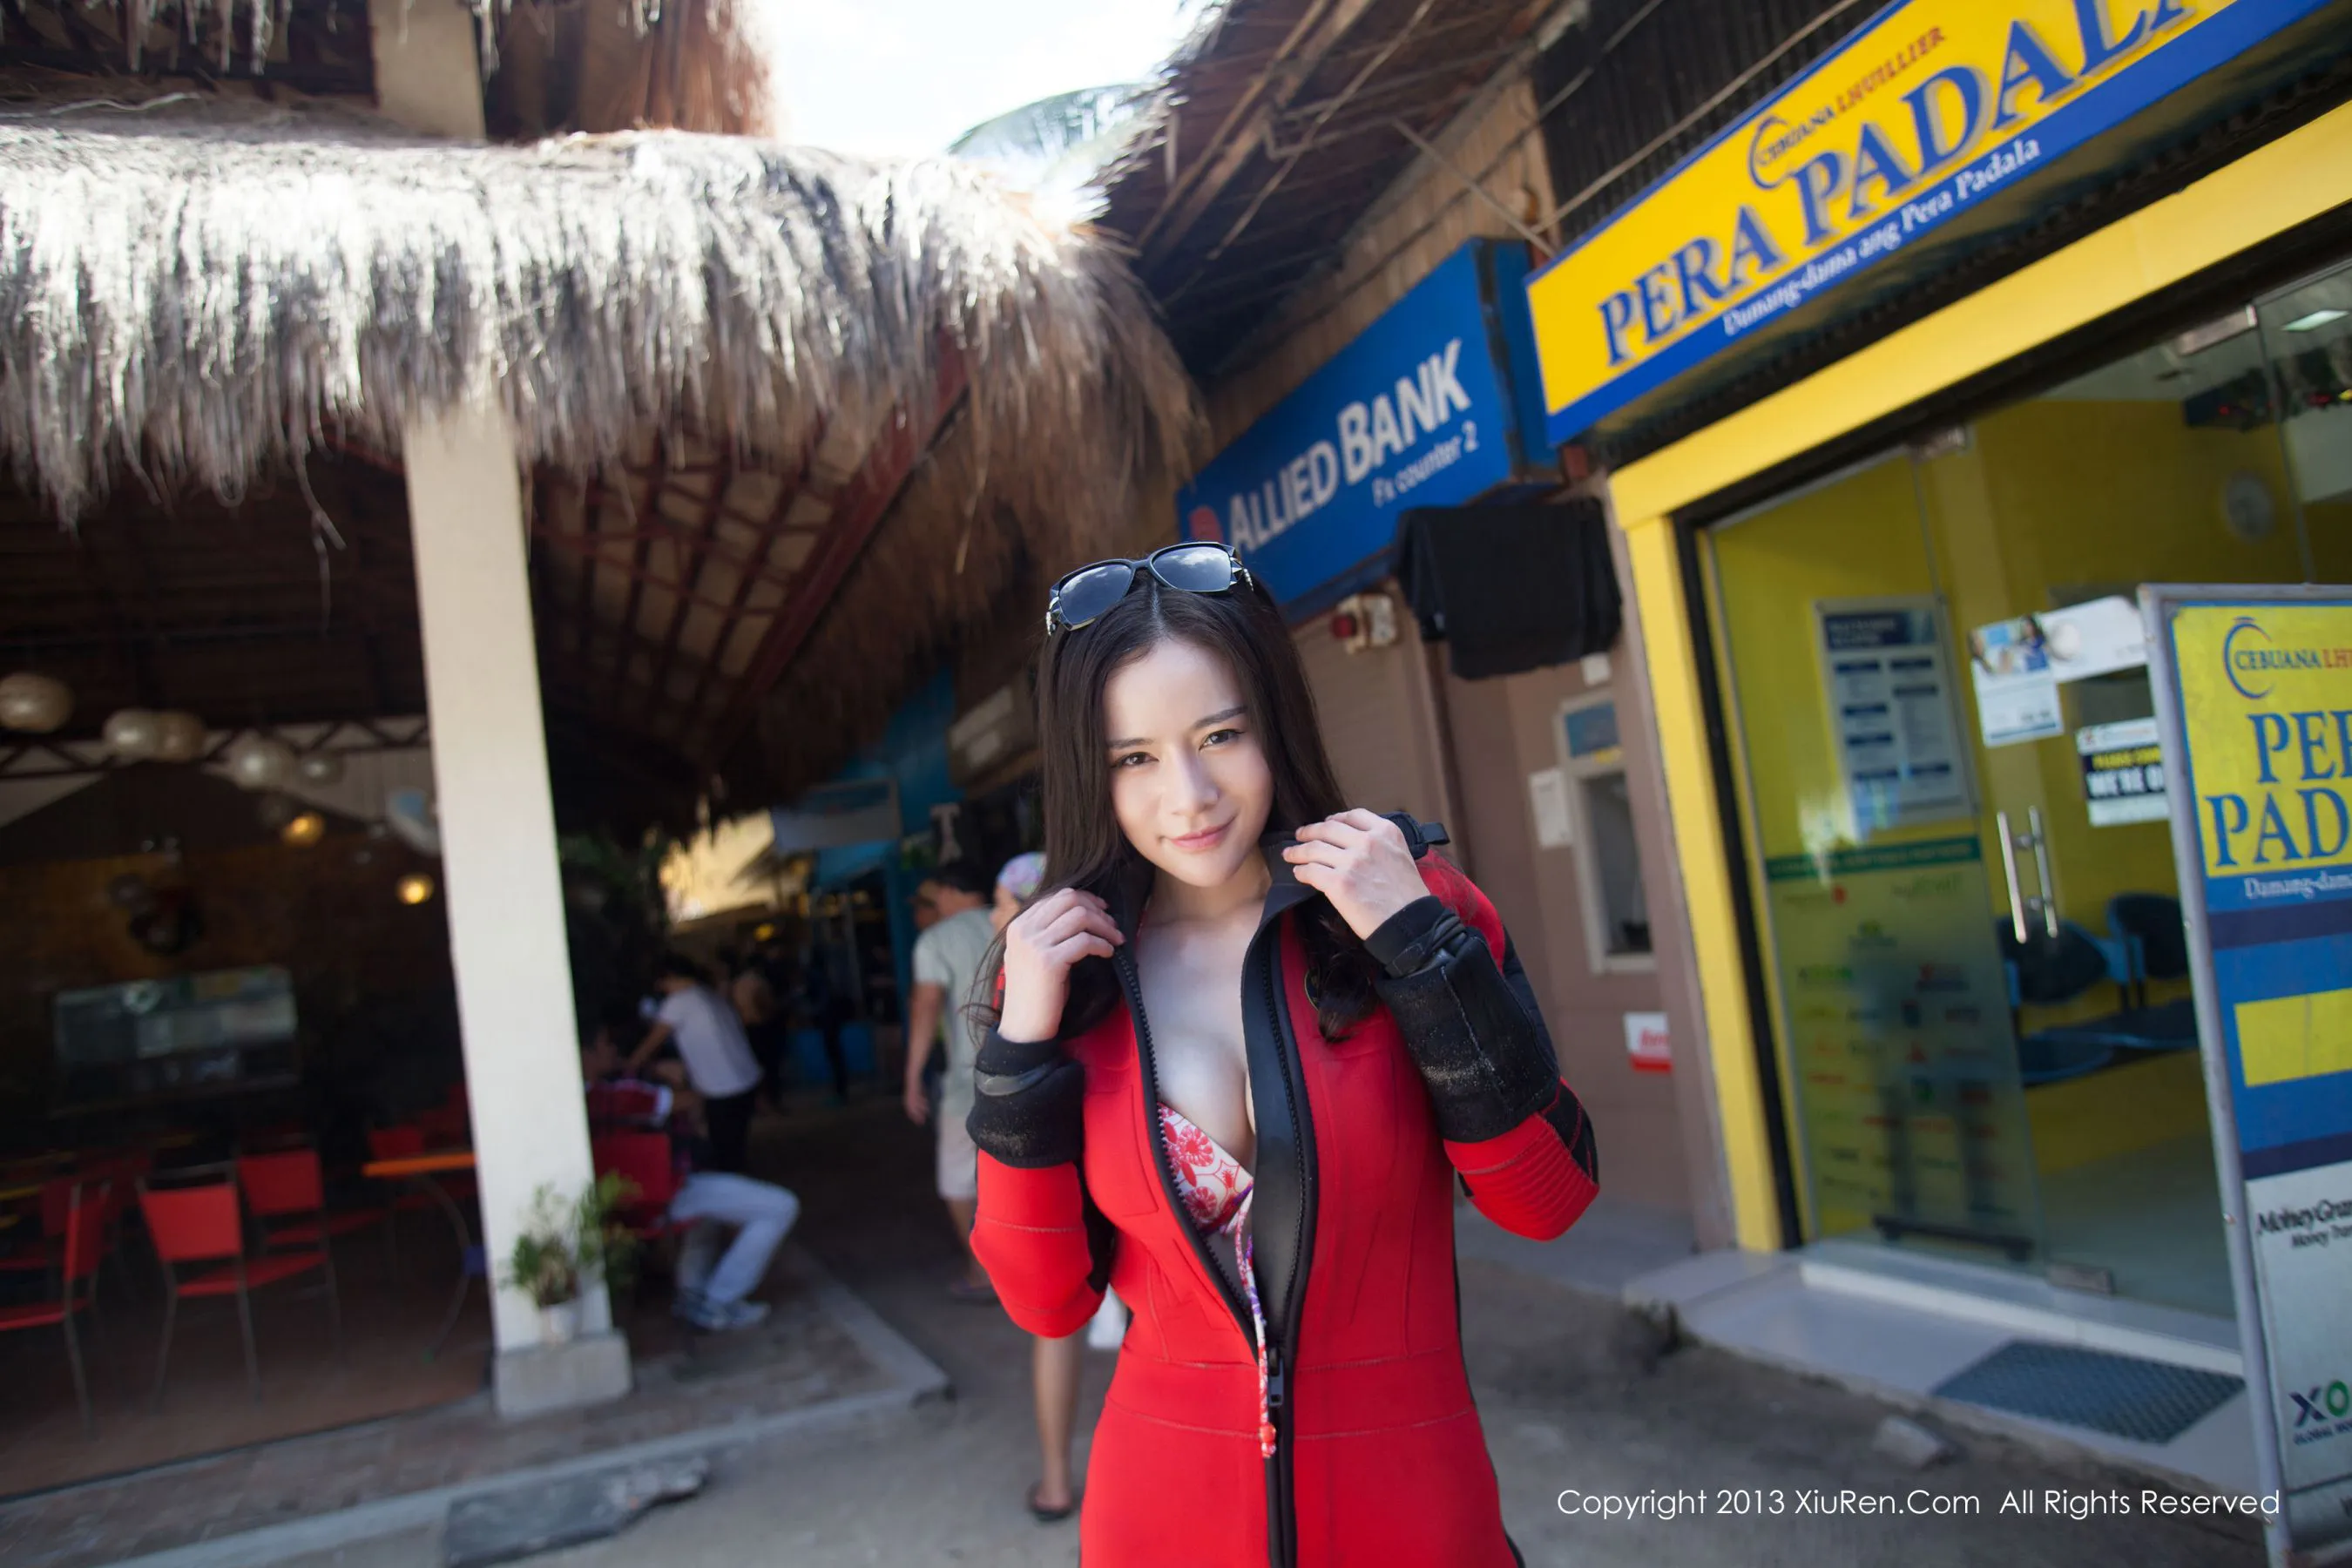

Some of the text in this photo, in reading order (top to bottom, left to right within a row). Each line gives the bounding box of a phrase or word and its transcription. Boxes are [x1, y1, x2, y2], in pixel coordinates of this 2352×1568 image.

[1835, 25, 1946, 113] LHUILLIER
[1857, 220, 1903, 259] ang
[1900, 188, 1954, 233] Pera
[1954, 138, 2041, 201] Padala
[1597, 204, 1790, 368] PERA
[1228, 337, 1471, 553] ALLIED BANK
[1395, 434, 1463, 495] counter
[1462, 419, 1480, 453] 2
[2234, 647, 2322, 672] CEBUANA
[2203, 787, 2352, 868] PAD
